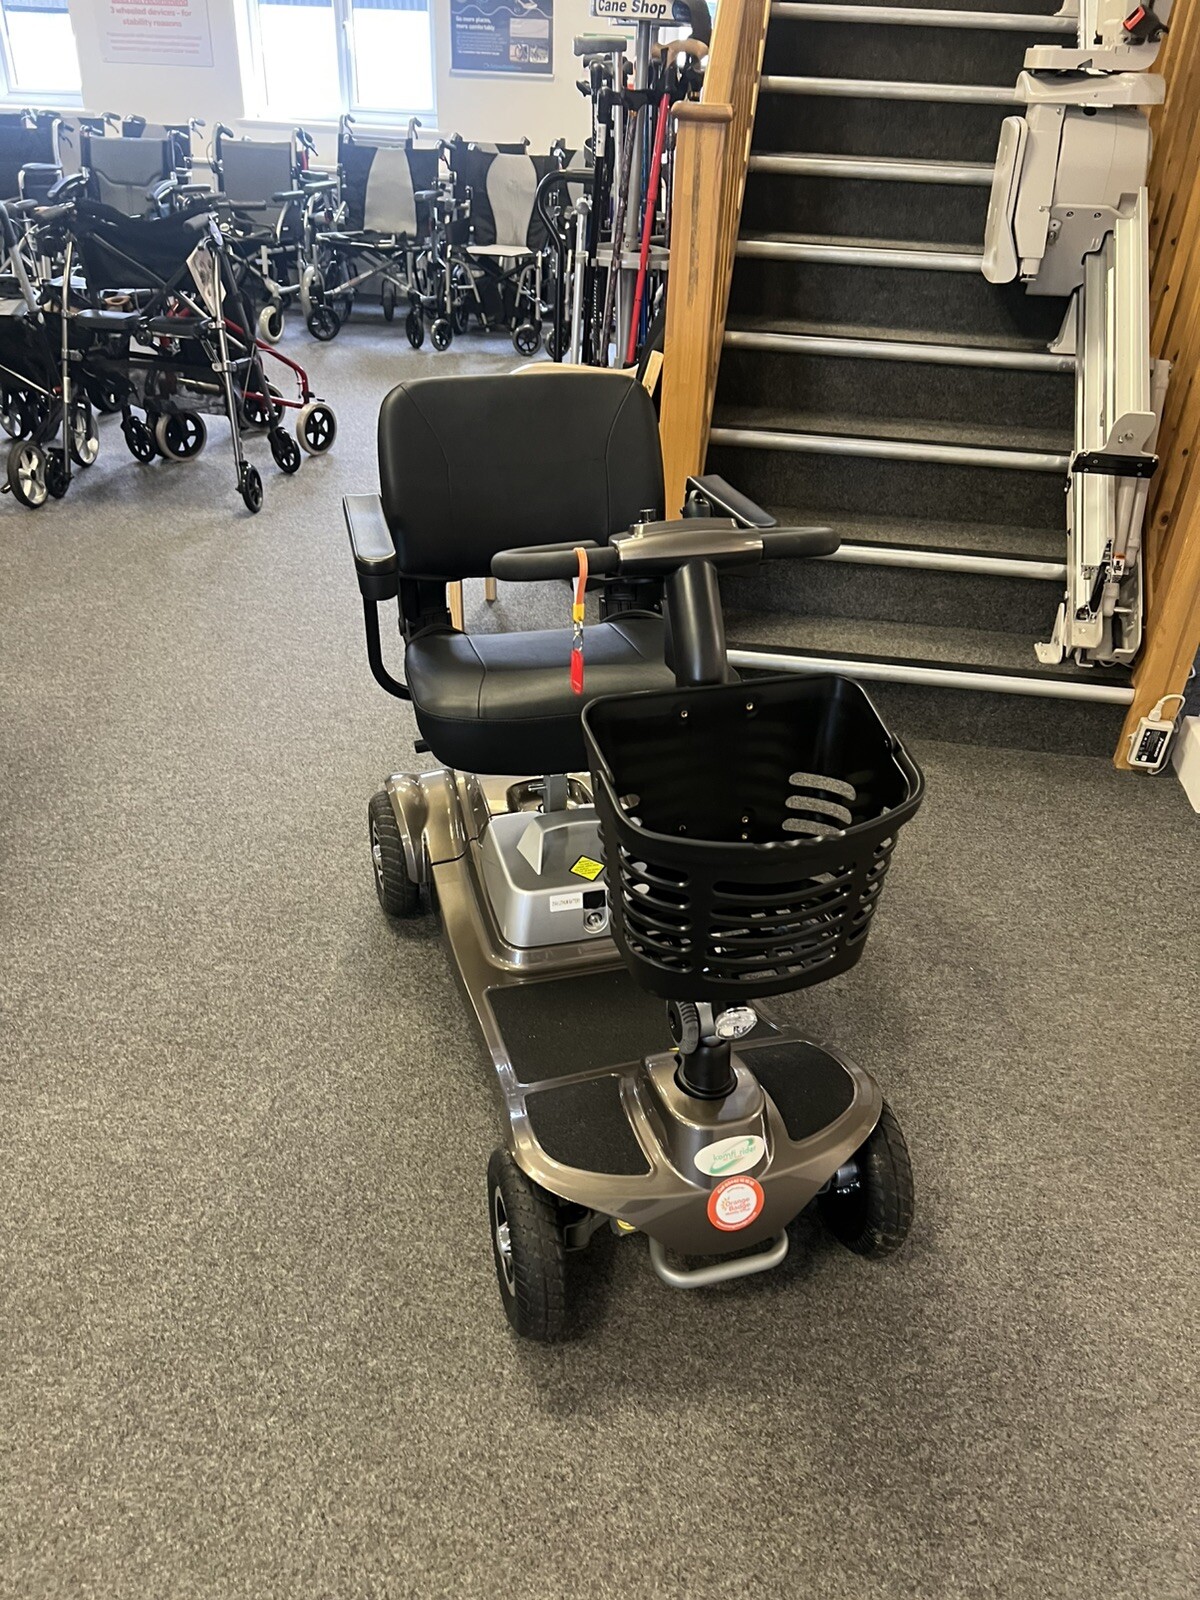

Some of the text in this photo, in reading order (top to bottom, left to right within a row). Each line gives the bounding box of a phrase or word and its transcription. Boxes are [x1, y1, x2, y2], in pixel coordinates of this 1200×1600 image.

[116, 7, 146, 15] wheeled
[148, 8, 175, 16] devices
[598, 0, 666, 19] Cane Shop
[123, 18, 152, 27] stability
[726, 1197, 750, 1208] Orange
[728, 1203, 750, 1211] Badge
